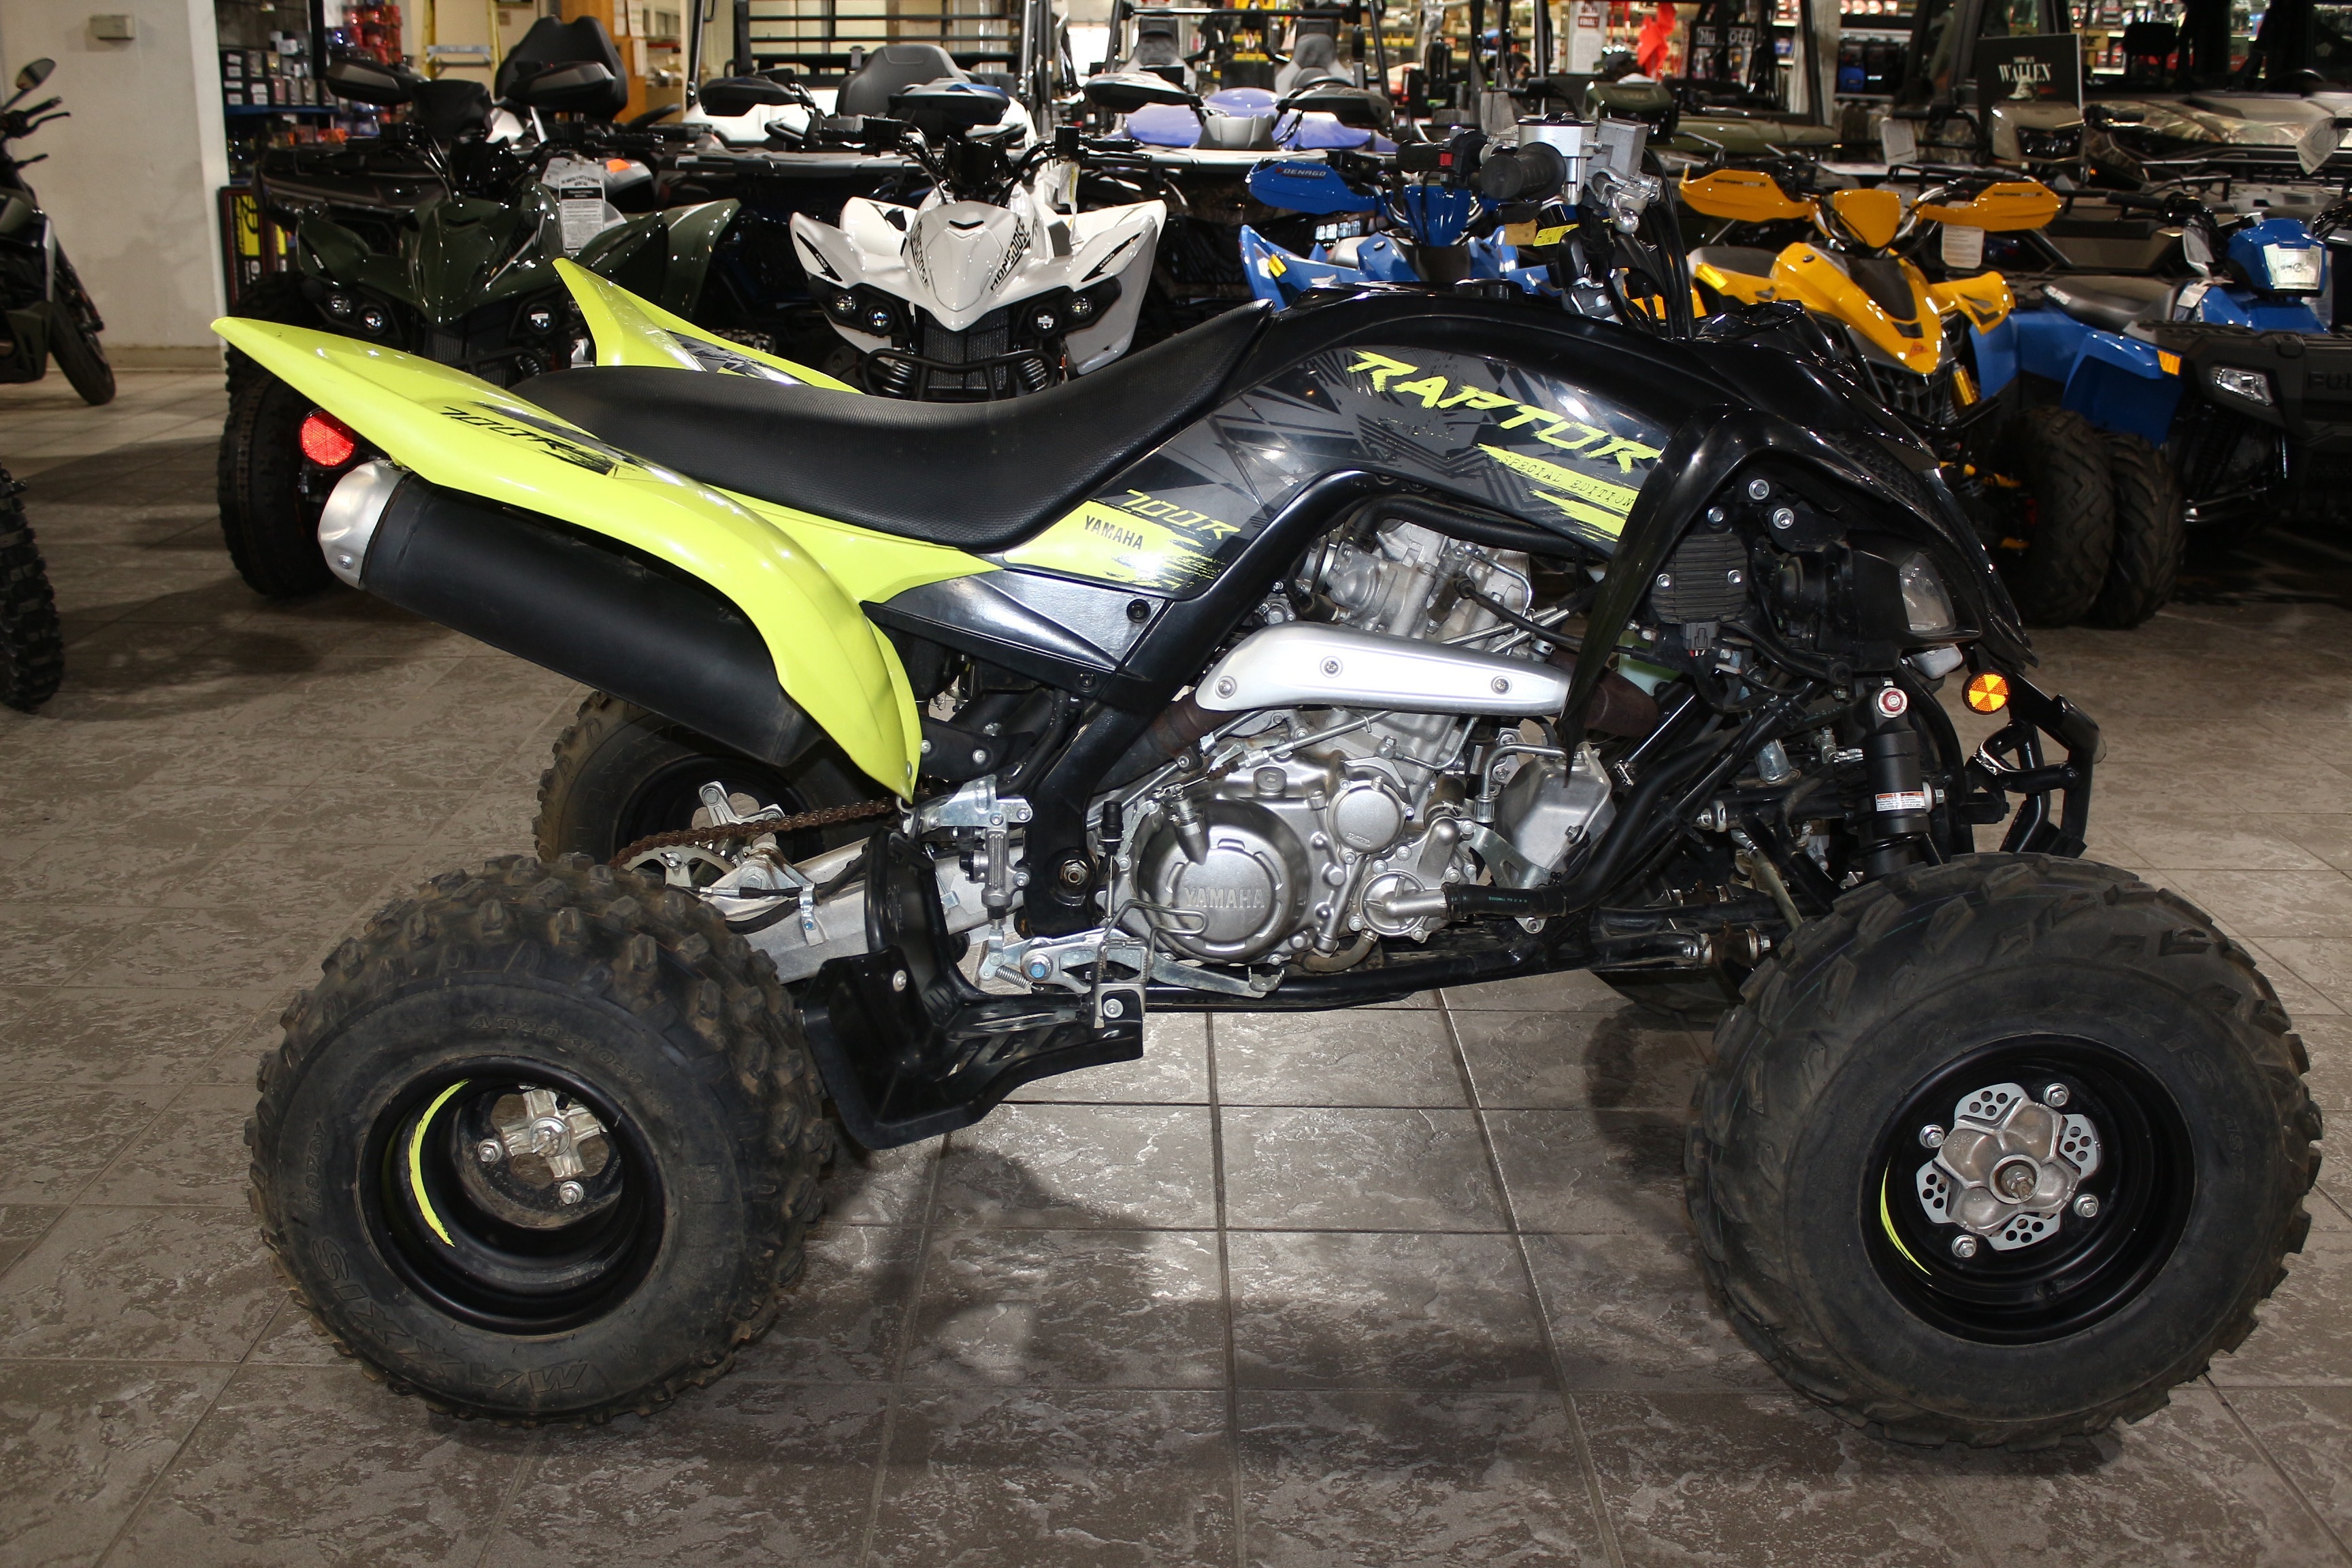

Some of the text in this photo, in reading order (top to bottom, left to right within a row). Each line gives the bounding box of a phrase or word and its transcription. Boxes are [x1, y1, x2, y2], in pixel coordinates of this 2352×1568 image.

[1283, 168, 1327, 177] DENAGO
[990, 216, 1030, 291] MONGOOSE
[1347, 348, 1661, 474] RAPTOR
[1501, 455, 1635, 508] SPECIAL EDITION
[1085, 514, 1144, 551] YAMAHA
[1184, 886, 1265, 909] YAMAHA
[312, 1237, 588, 1394] MAXXIS
